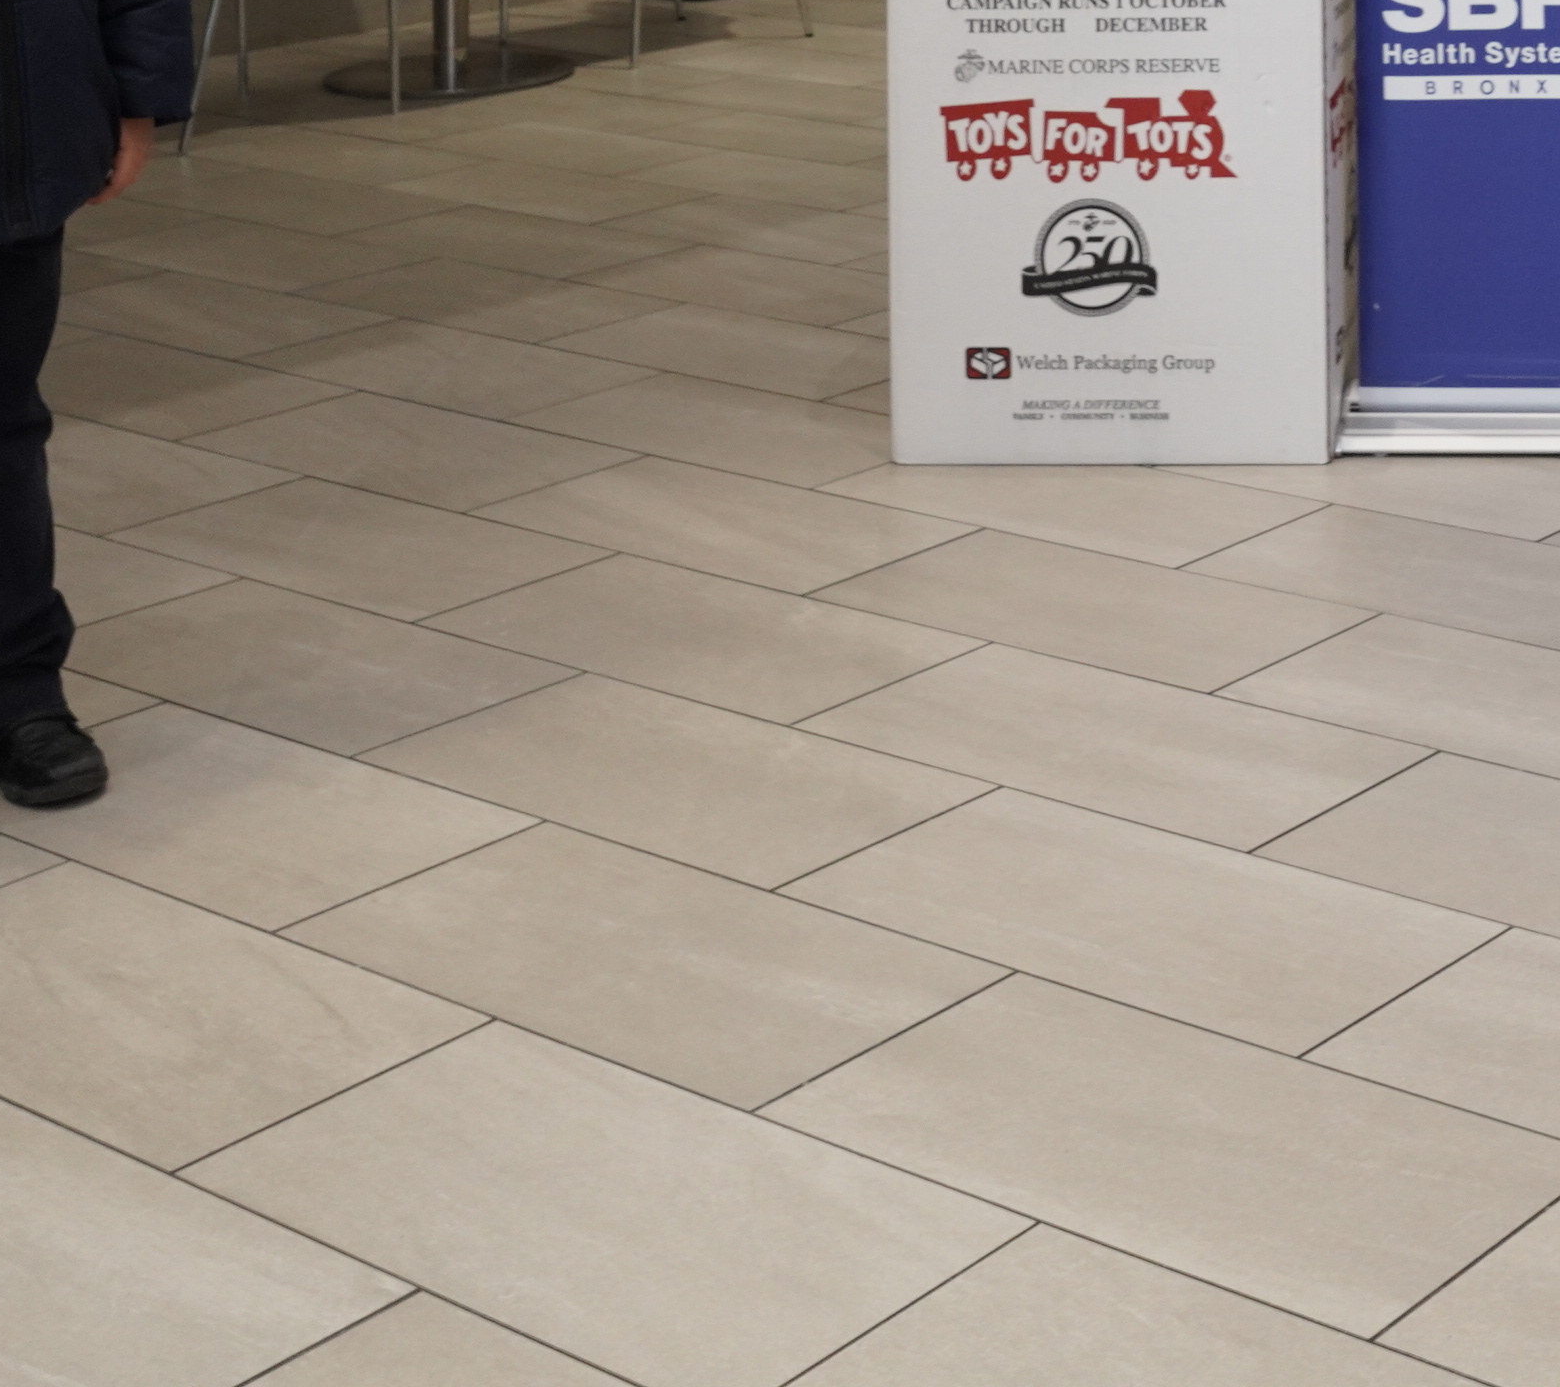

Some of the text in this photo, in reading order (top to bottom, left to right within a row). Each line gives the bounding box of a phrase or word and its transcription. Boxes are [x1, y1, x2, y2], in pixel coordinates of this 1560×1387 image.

[965, 17, 1208, 34] THROUGH DECEMBER
[1384, 43, 1475, 64] Health
[988, 58, 1221, 75] MARINE CORPS RESERVE
[1423, 79, 1547, 96] BRONX
[948, 110, 1214, 161] TOYS FOR TOTS
[1016, 354, 1216, 374] Welch Packaging Group
